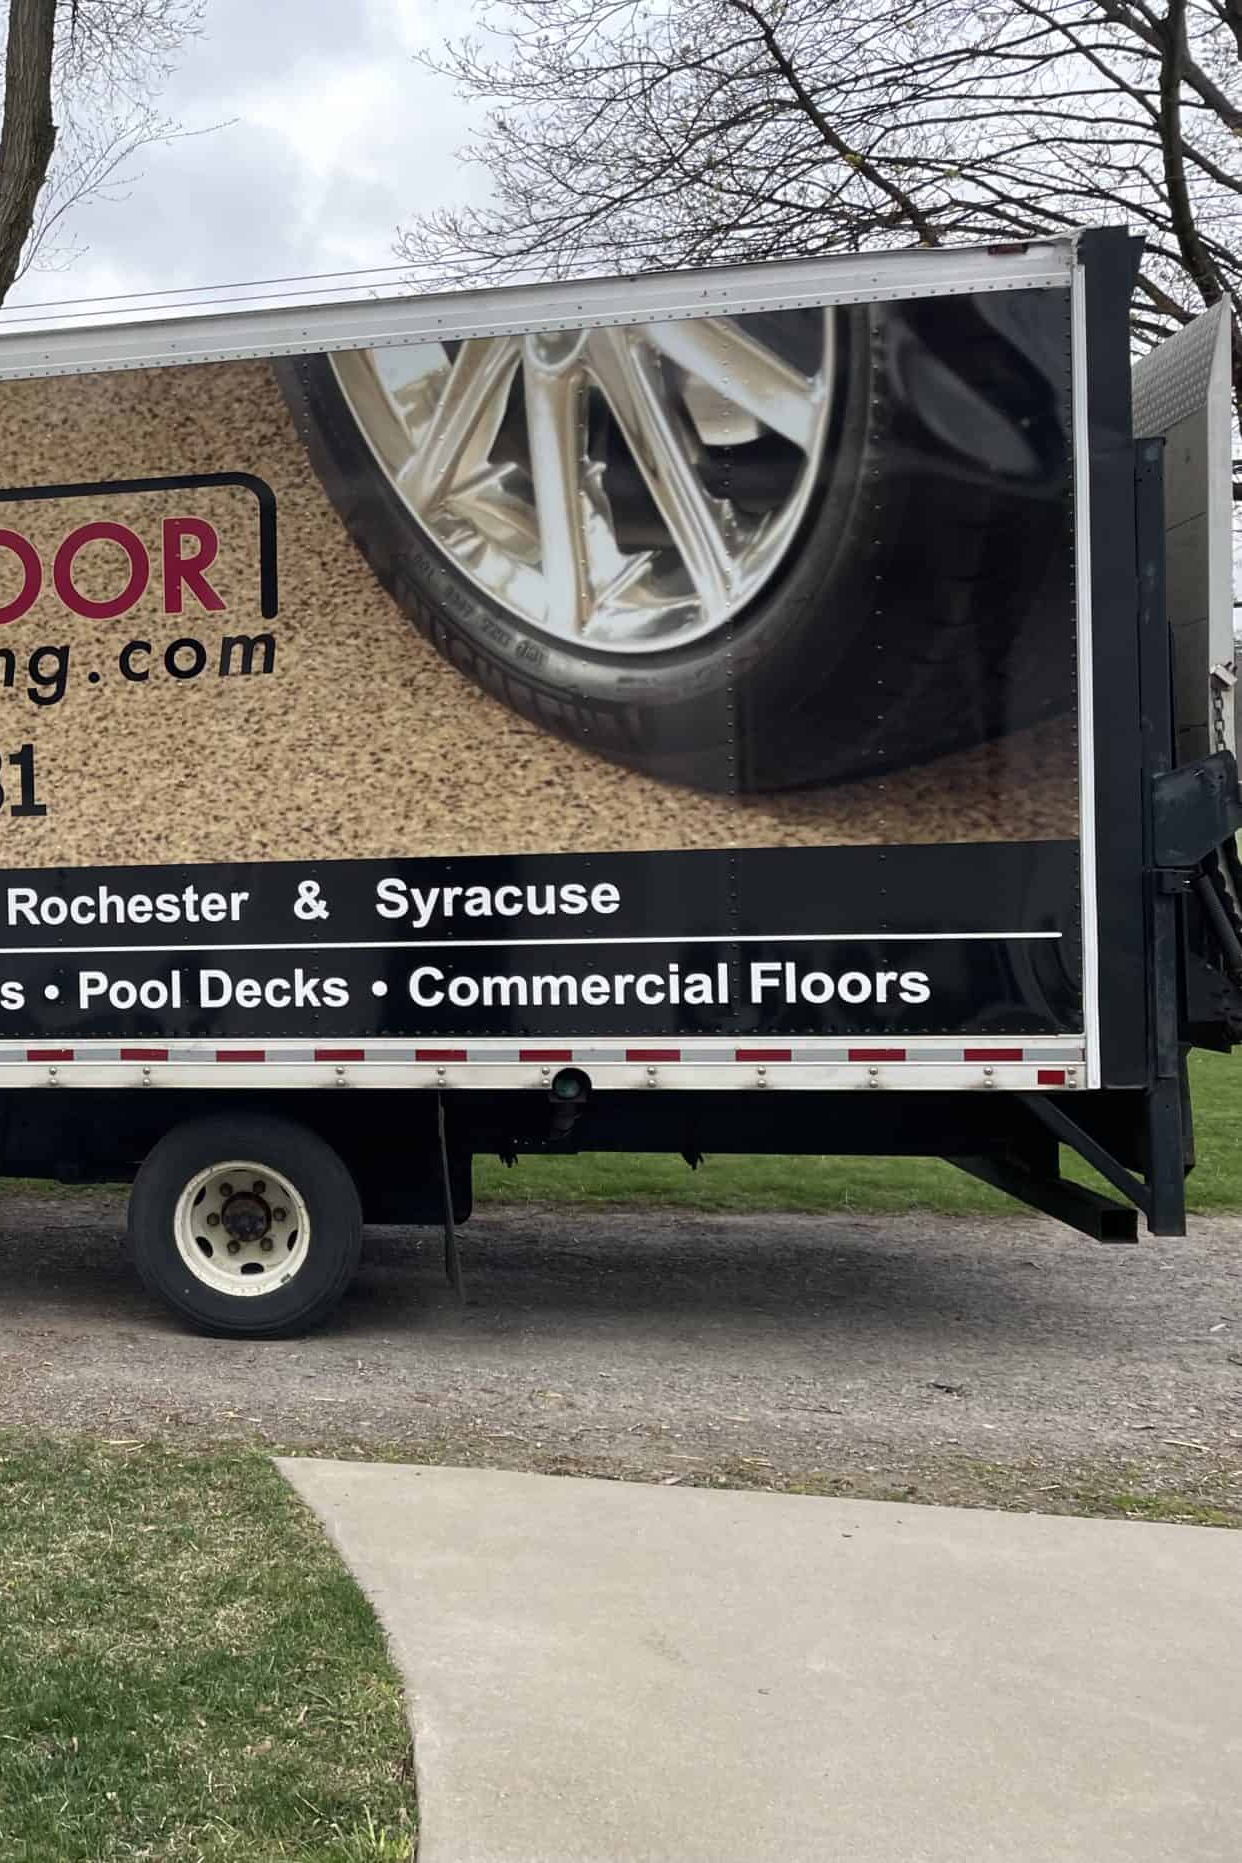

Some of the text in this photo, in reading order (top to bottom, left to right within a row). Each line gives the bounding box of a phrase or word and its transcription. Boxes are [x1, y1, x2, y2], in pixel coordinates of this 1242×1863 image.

[7, 885, 250, 926] Rochester
[294, 880, 330, 920] &
[375, 878, 621, 928] Syracuse
[79, 970, 181, 1009] Pool
[199, 968, 350, 1008] Decks
[409, 962, 729, 1007] Commercial
[750, 961, 931, 1004] Floors
